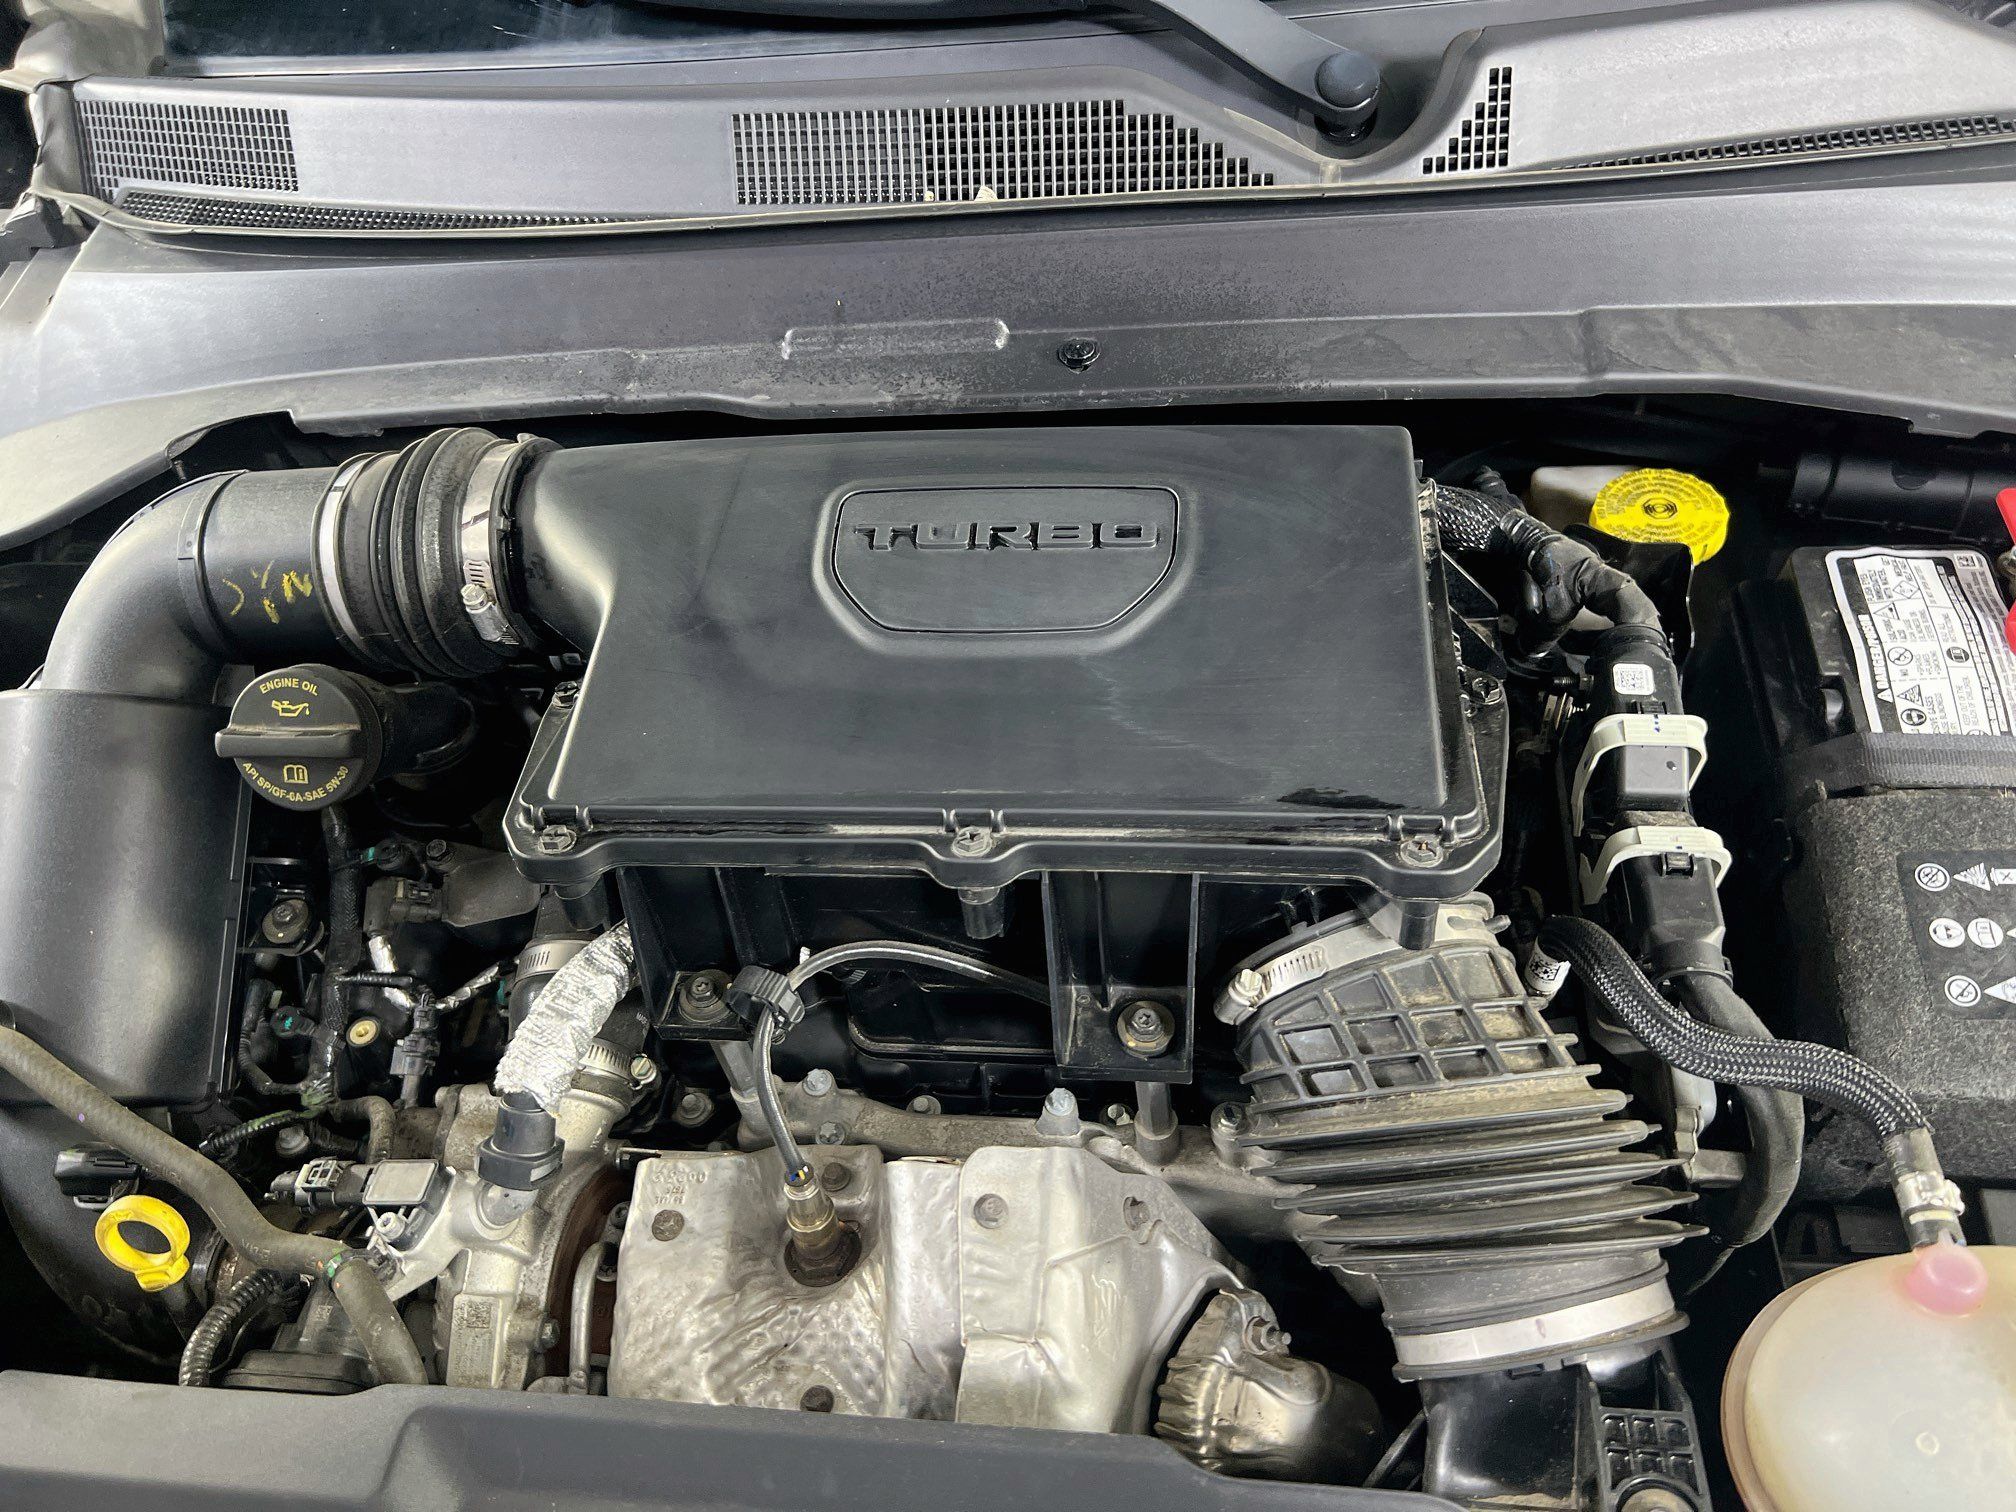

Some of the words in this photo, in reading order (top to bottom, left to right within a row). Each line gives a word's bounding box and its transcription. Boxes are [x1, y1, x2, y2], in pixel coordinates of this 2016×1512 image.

[854, 521, 1160, 550] TURBO
[1858, 614, 1889, 689] DANGER/POISON
[259, 678, 300, 694] ENGINE
[301, 680, 319, 696] OIL
[242, 760, 258, 780] API
[257, 776, 326, 802] SP/GF-6A-SAE
[326, 765, 349, 792] 5W-30
